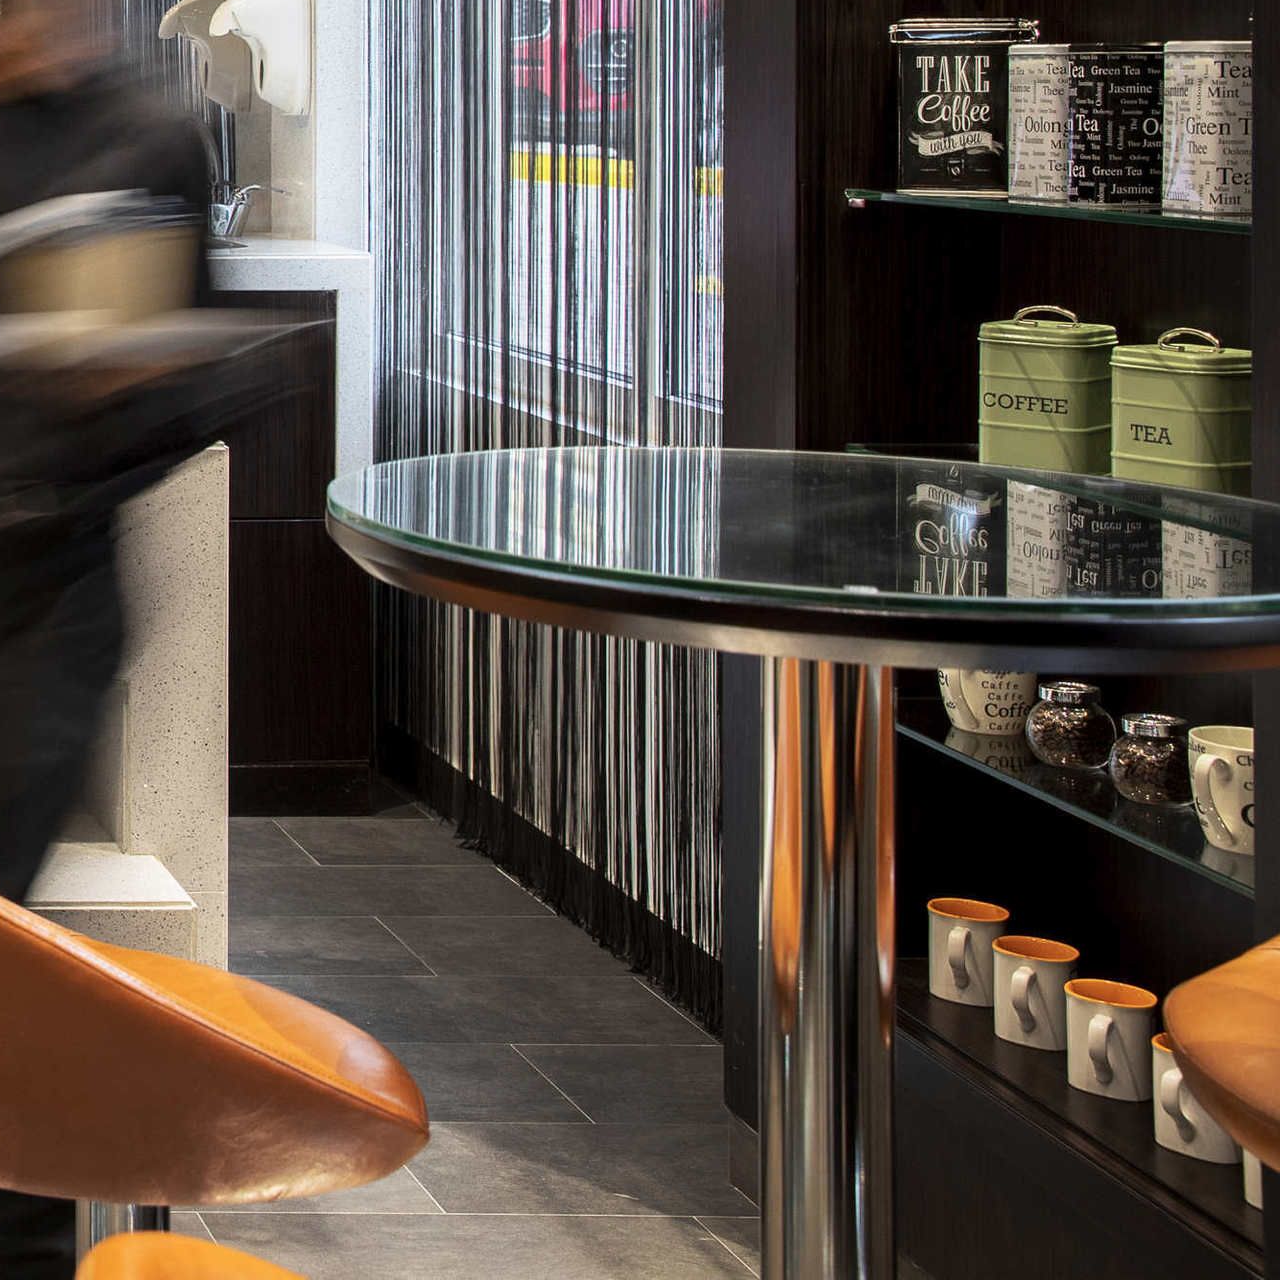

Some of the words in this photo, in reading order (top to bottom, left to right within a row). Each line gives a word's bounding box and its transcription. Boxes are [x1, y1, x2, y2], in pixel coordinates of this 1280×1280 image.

[916, 55, 990, 93] TAKE
[1091, 65, 1121, 76] Green
[1122, 65, 1141, 76] Tea
[1108, 82, 1153, 94] Jasmine
[1207, 86, 1240, 99] Mint
[917, 94, 991, 132] Coffee
[929, 137, 957, 153] with
[959, 132, 983, 148] you
[982, 391, 1069, 415] COFFEE
[1130, 423, 1173, 446] TEA
[981, 680, 1020, 690] Caffe
[987, 692, 1024, 701] Caffe
